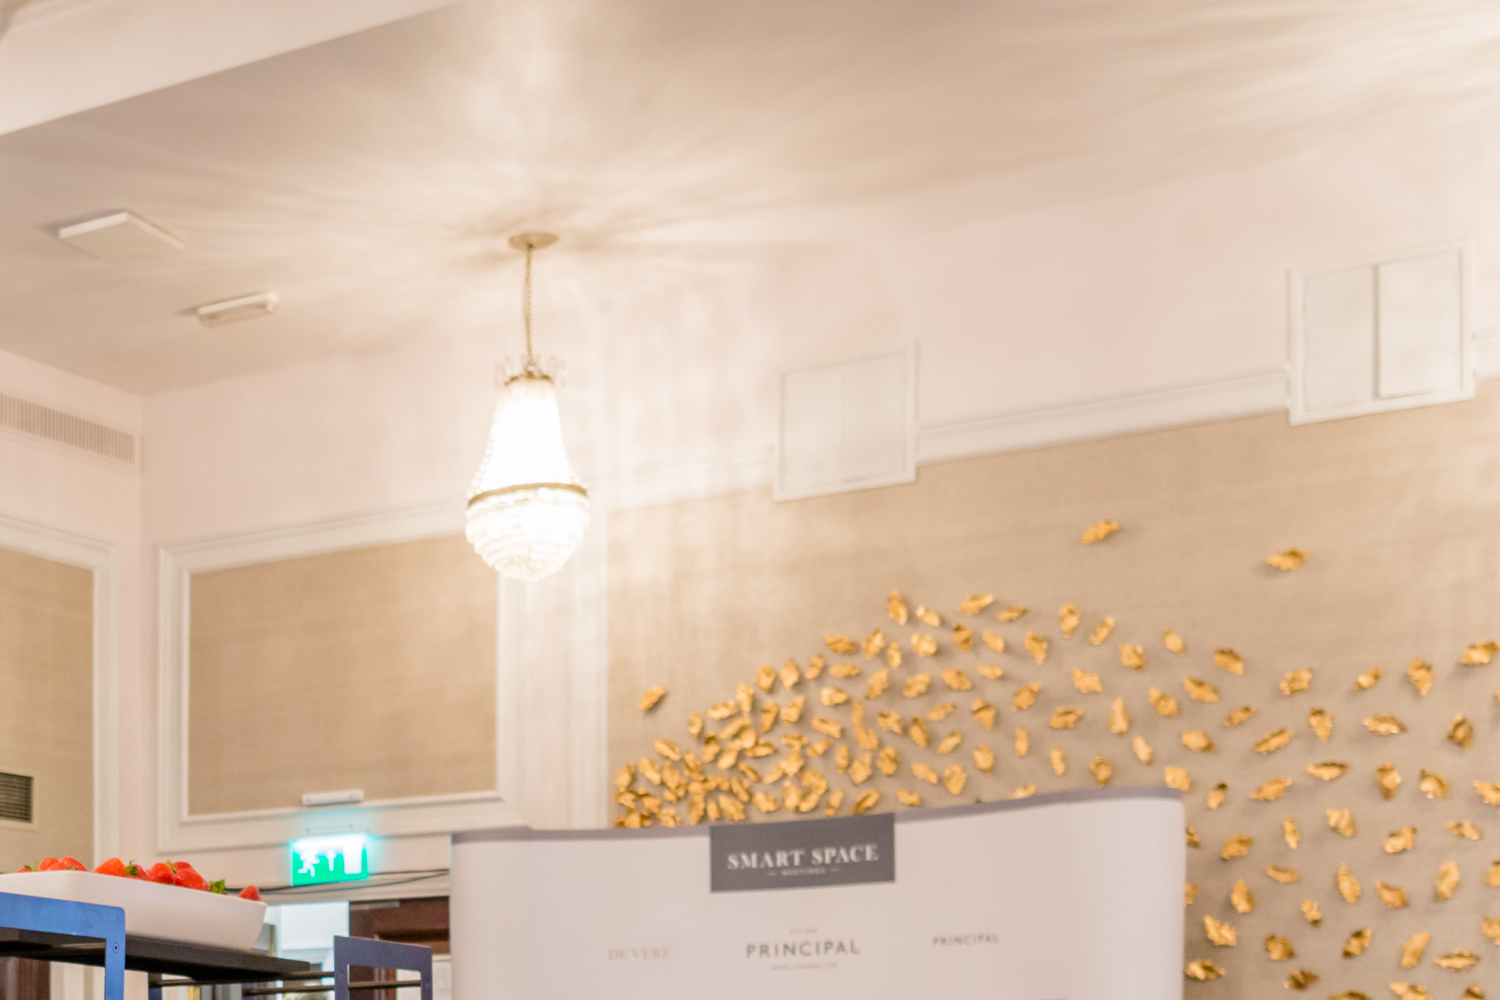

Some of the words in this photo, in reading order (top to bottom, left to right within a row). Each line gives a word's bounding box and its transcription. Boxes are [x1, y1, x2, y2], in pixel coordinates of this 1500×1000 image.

[727, 849, 805, 871] SMART
[810, 842, 880, 866] SPACE
[932, 932, 999, 947] PRINCIPAL
[607, 948, 627, 961] DE
[630, 947, 672, 961] VERE
[745, 939, 861, 960] PRINCIPAL
